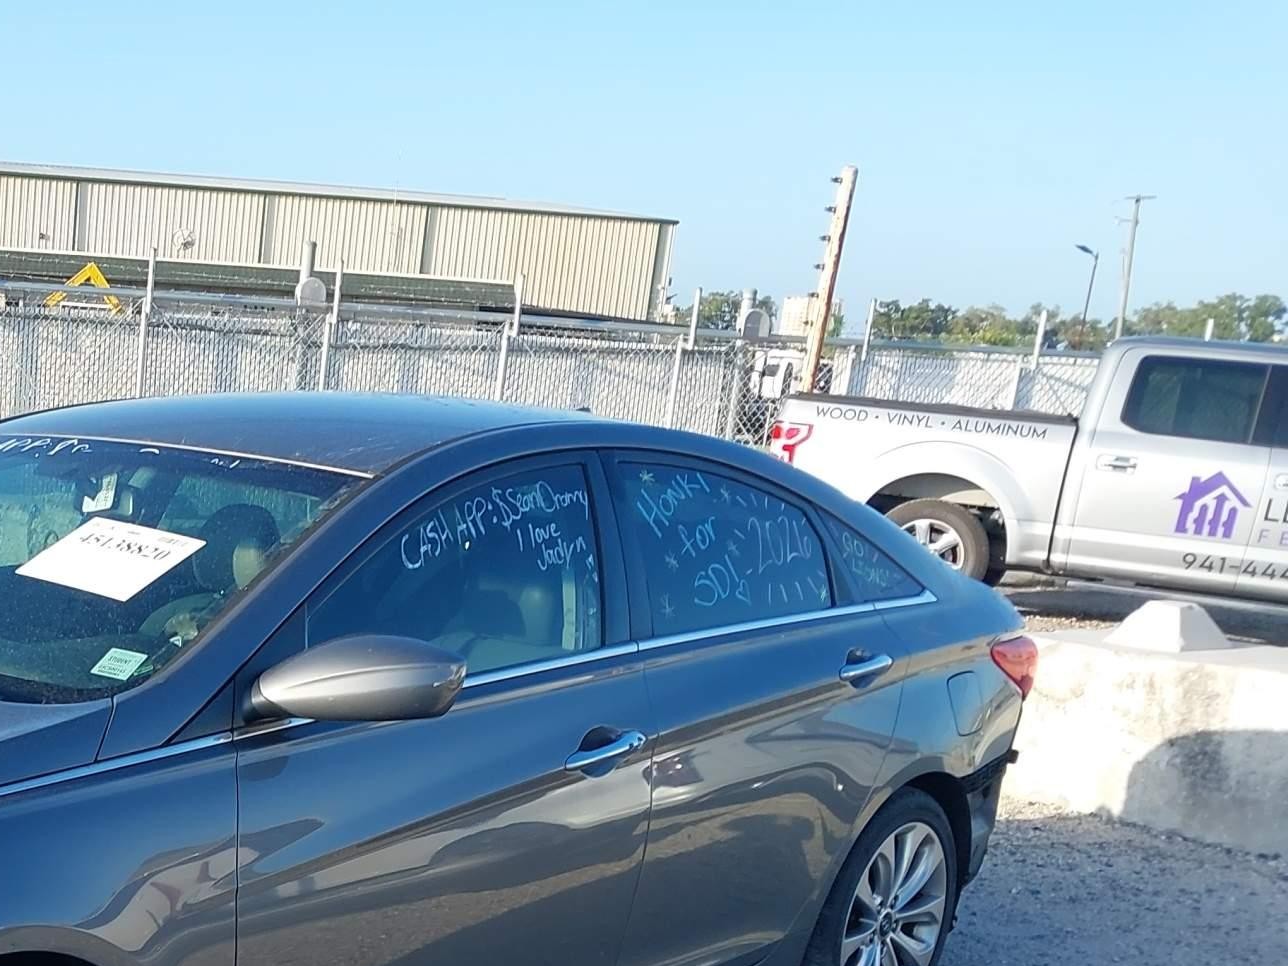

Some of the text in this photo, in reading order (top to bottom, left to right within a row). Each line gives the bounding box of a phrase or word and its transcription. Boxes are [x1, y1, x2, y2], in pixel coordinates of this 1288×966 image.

[816, 405, 1049, 440] WOOD VINYL ALUMINUM
[400, 508, 454, 570] CASH
[528, 522, 561, 549] love
